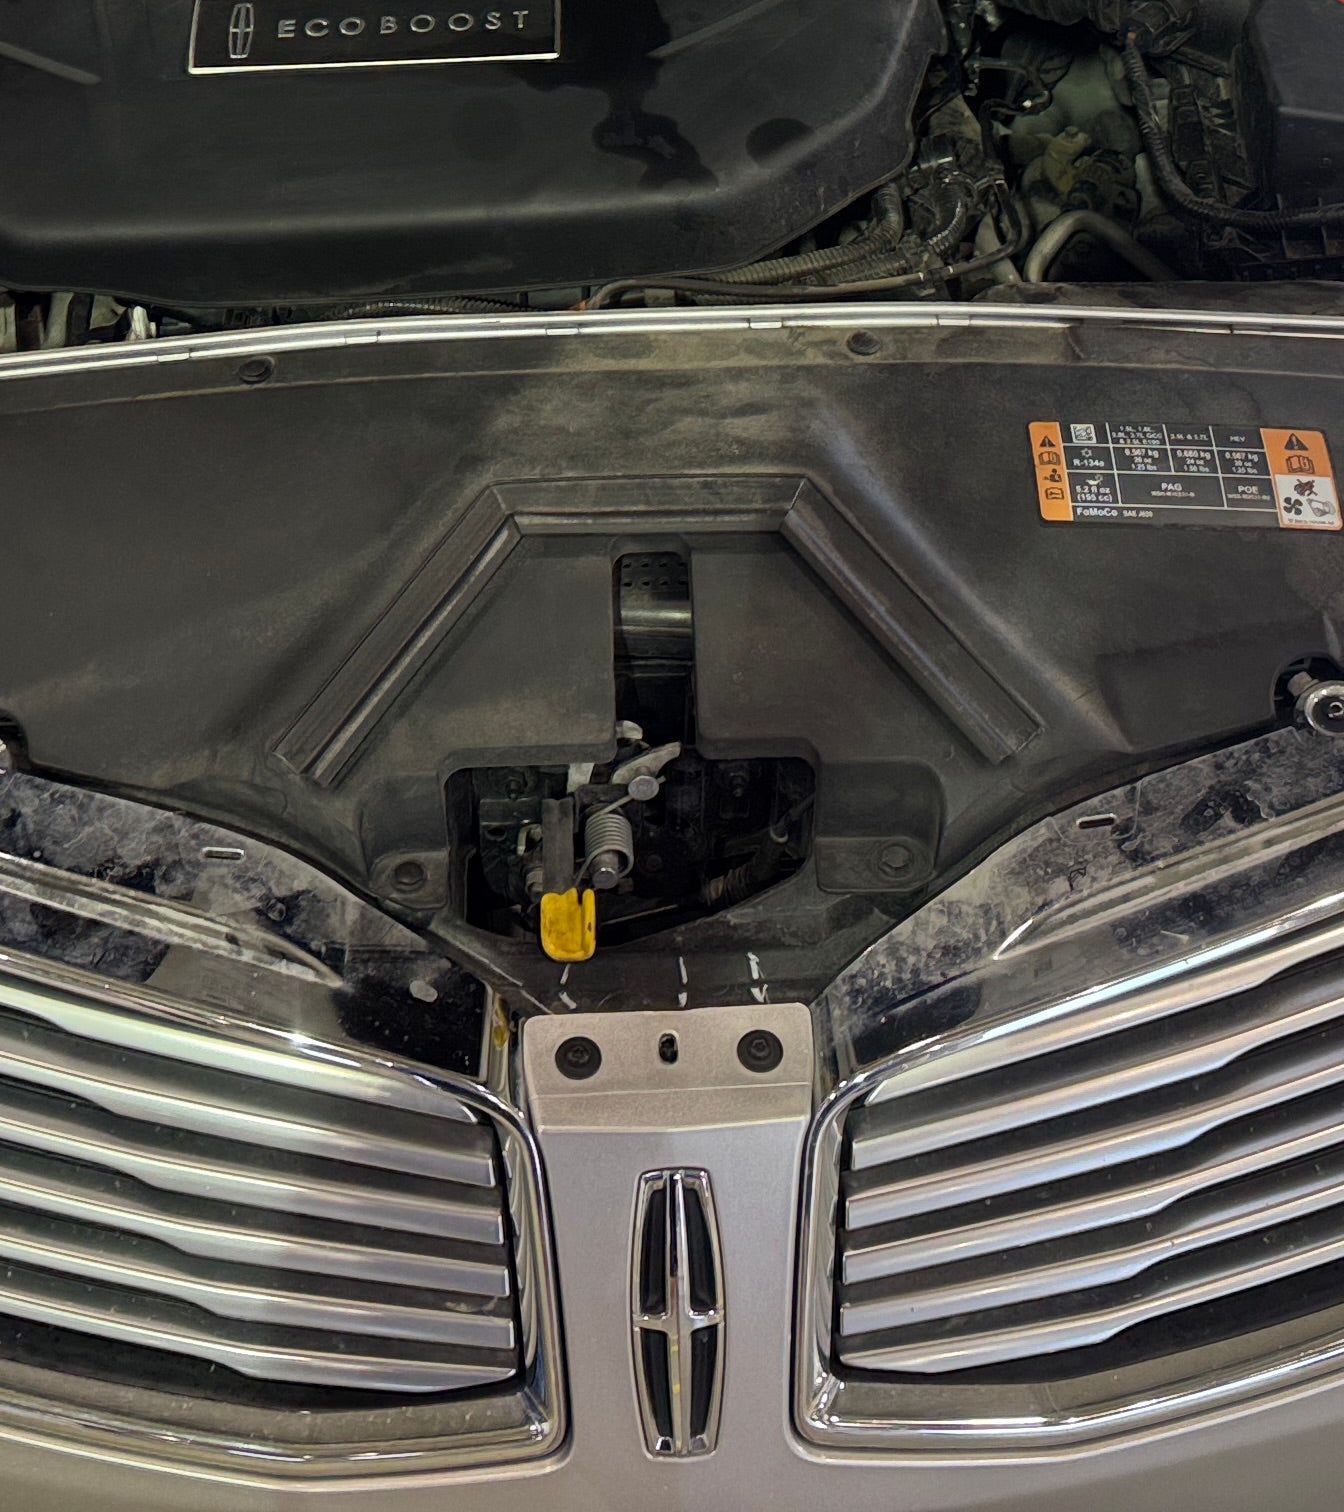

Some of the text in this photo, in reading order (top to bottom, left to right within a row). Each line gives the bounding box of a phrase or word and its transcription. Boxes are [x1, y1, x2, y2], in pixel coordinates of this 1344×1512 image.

[276, 9, 530, 40] ECOBOOST
[1147, 449, 1159, 459] kg
[1200, 450, 1211, 460] kg
[1073, 458, 1105, 467] R-134a
[1160, 482, 1183, 491] PAG
[1237, 485, 1259, 494] POE
[1098, 494, 1113, 502] cc)
[1076, 507, 1118, 517] FoMoCo
